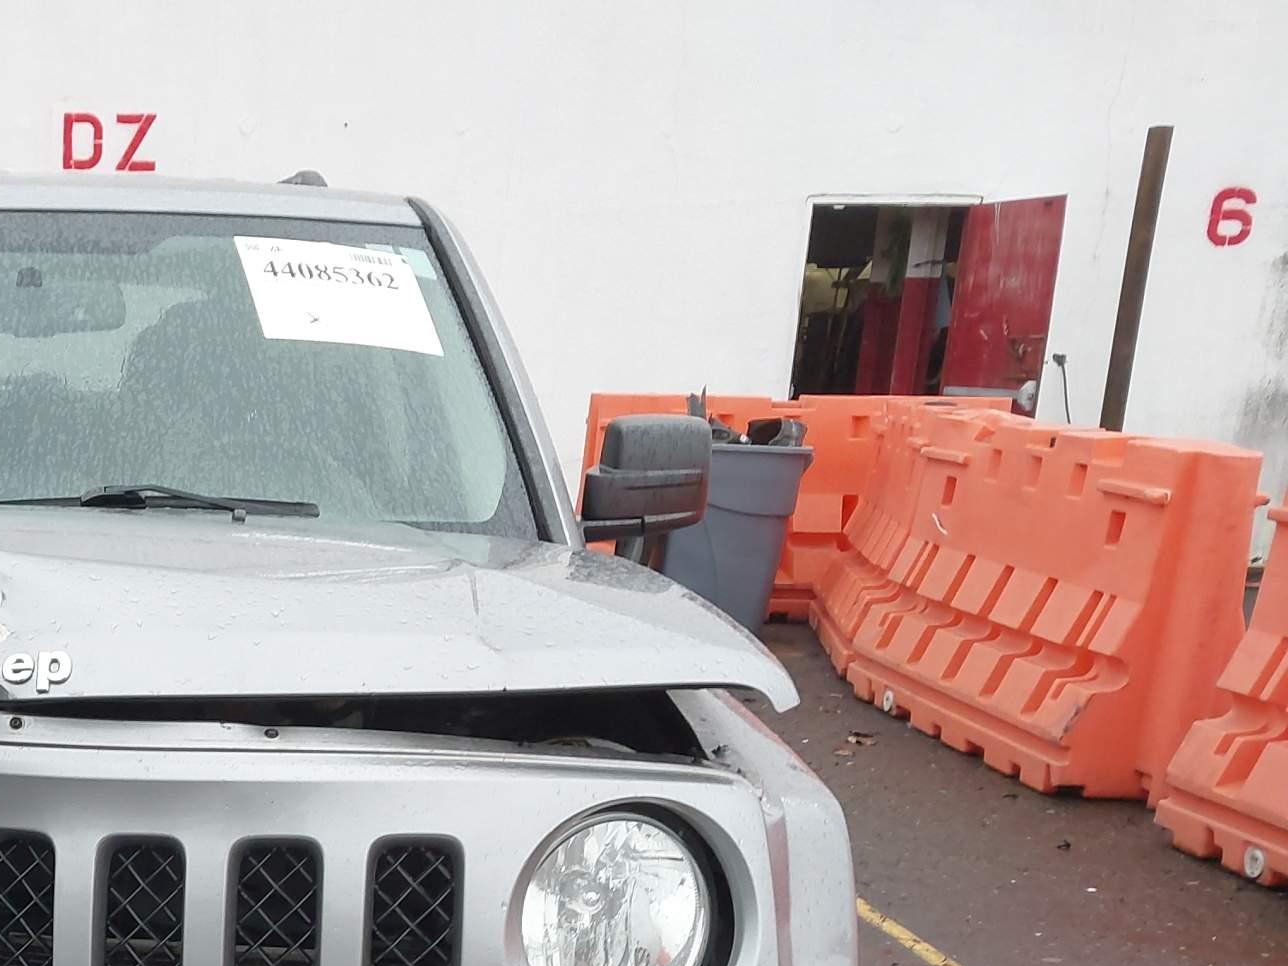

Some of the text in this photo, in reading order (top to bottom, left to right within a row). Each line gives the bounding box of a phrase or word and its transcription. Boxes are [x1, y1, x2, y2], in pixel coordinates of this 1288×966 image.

[62, 112, 157, 171] DZ
[1207, 186, 1257, 246] 6
[263, 259, 400, 290] 44085362
